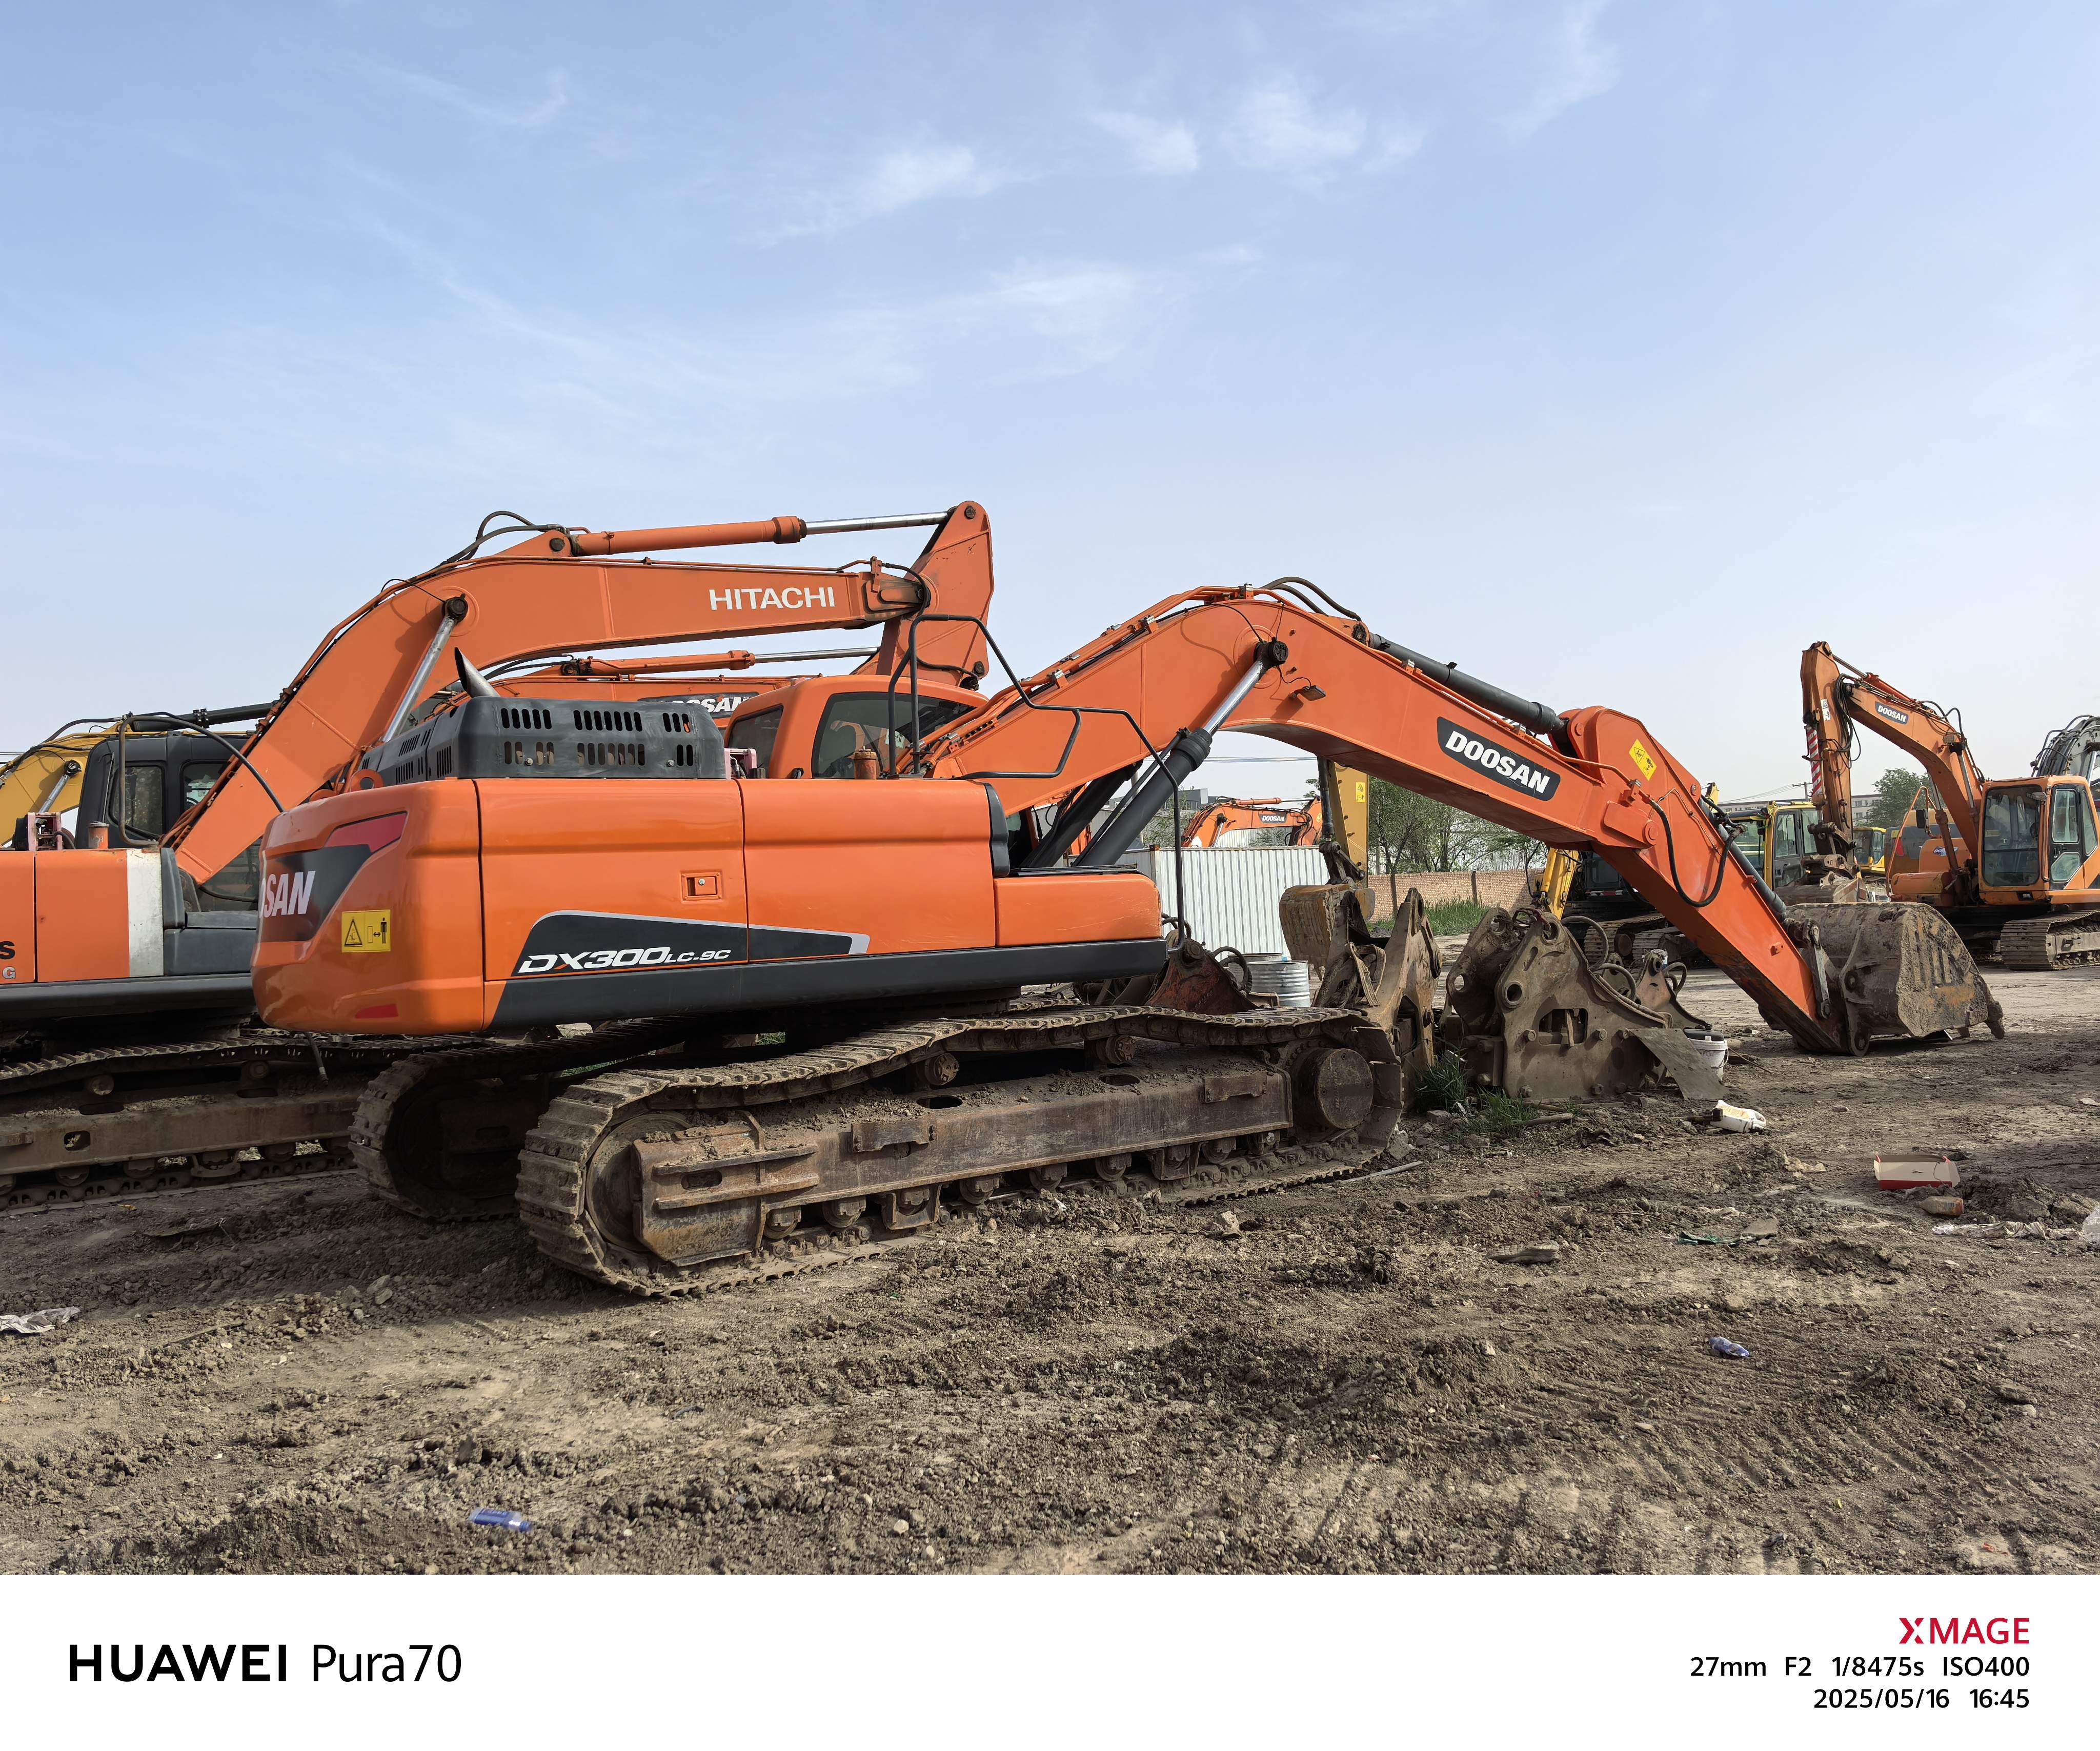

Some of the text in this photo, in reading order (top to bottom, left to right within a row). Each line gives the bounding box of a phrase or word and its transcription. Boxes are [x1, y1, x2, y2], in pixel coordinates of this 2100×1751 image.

[709, 587, 835, 610] HITACHI
[655, 696, 749, 713] SAN
[1877, 705, 1906, 722] DOOSAN
[1445, 730, 1550, 793] DOOSAN
